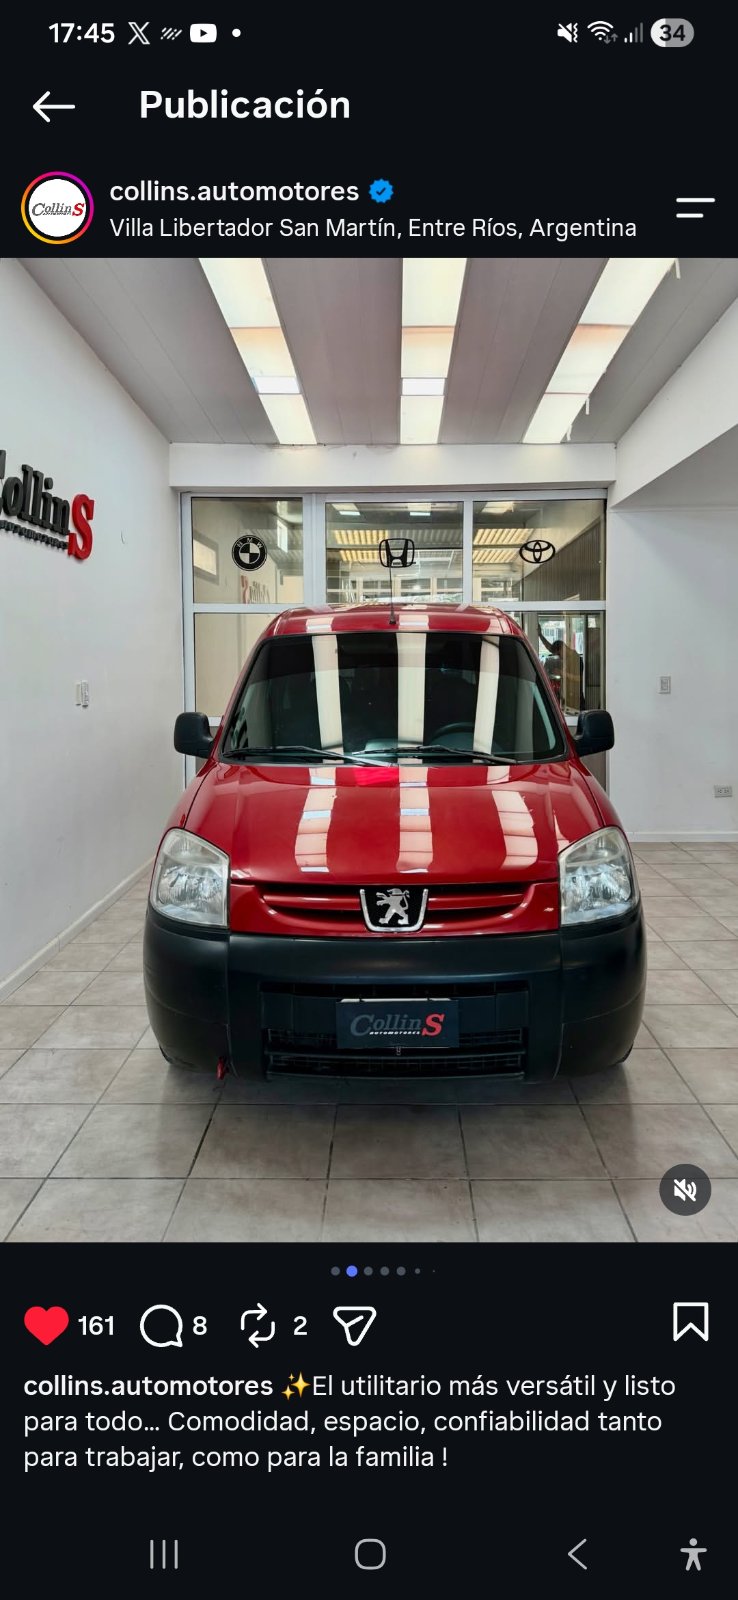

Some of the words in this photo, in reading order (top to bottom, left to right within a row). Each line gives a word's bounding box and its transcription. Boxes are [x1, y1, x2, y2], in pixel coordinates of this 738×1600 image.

[49, 23, 115, 43] 17:45
[660, 24, 686, 41] 34
[139, 89, 350, 118] Publicación
[109, 180, 360, 202] collins.automotores
[110, 218, 153, 236] Villa
[161, 218, 273, 236] Libertador
[280, 219, 318, 236] San
[327, 218, 401, 240] Martín,
[409, 219, 465, 236] Entre
[473, 218, 522, 240] Ríos,
[529, 218, 636, 242] Argentina
[78, 1316, 114, 1336] 161
[193, 1316, 208, 1336] 8
[294, 1316, 308, 1336] 2
[24, 1374, 274, 1396] collins.automotores
[313, 1375, 332, 1396] El
[342, 1375, 441, 1396] utilitario
[450, 1375, 498, 1396] más
[506, 1375, 595, 1396] versátil
[603, 1380, 617, 1402] y
[626, 1375, 676, 1396] listo
[25, 1415, 78, 1438] para
[169, 1410, 315, 1435] Comodidad,
[324, 1410, 426, 1438] espacio,
[434, 1410, 590, 1432] confiabilidad
[598, 1412, 663, 1432] tanto
[25, 1450, 78, 1473] para
[85, 1446, 184, 1473] trabajar,
[193, 1450, 260, 1467] como
[268, 1450, 321, 1473] para
[330, 1446, 348, 1467] la
[356, 1446, 434, 1467] familia
